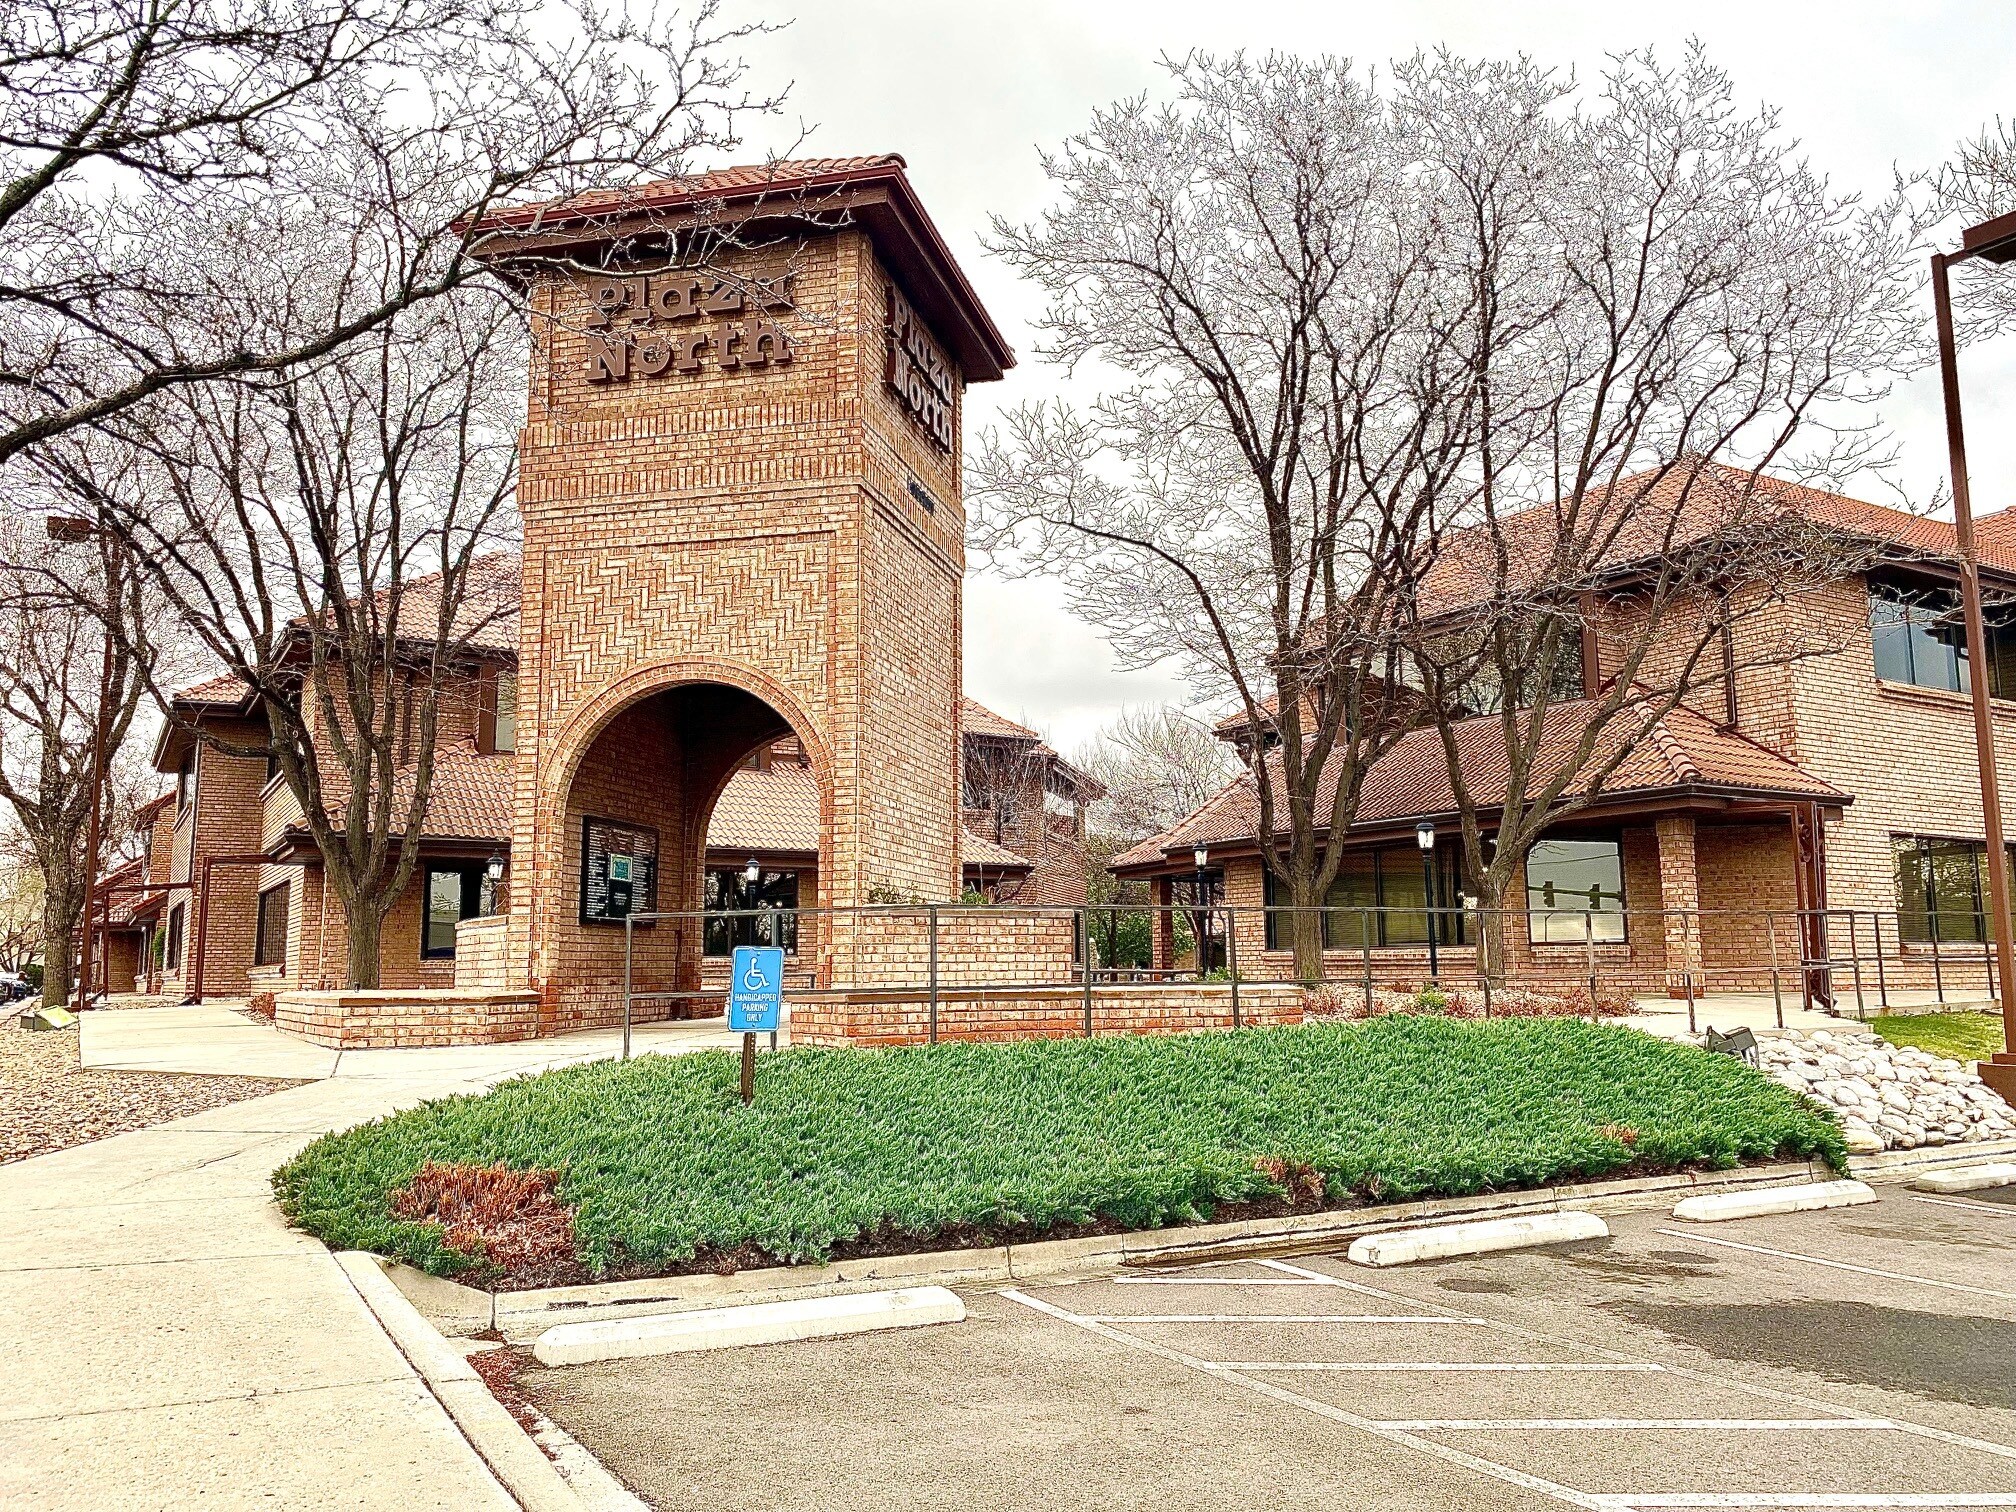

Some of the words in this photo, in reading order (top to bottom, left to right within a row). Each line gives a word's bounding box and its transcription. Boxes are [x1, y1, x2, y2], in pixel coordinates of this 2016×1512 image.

[587, 268, 793, 327] Plaza
[585, 318, 792, 382] North
[888, 287, 953, 405] Plaza
[888, 339, 952, 453] North
[735, 993, 776, 1002] HANDICAPPED
[742, 1003, 768, 1012] PARKING
[746, 1014, 762, 1022] ONLY
